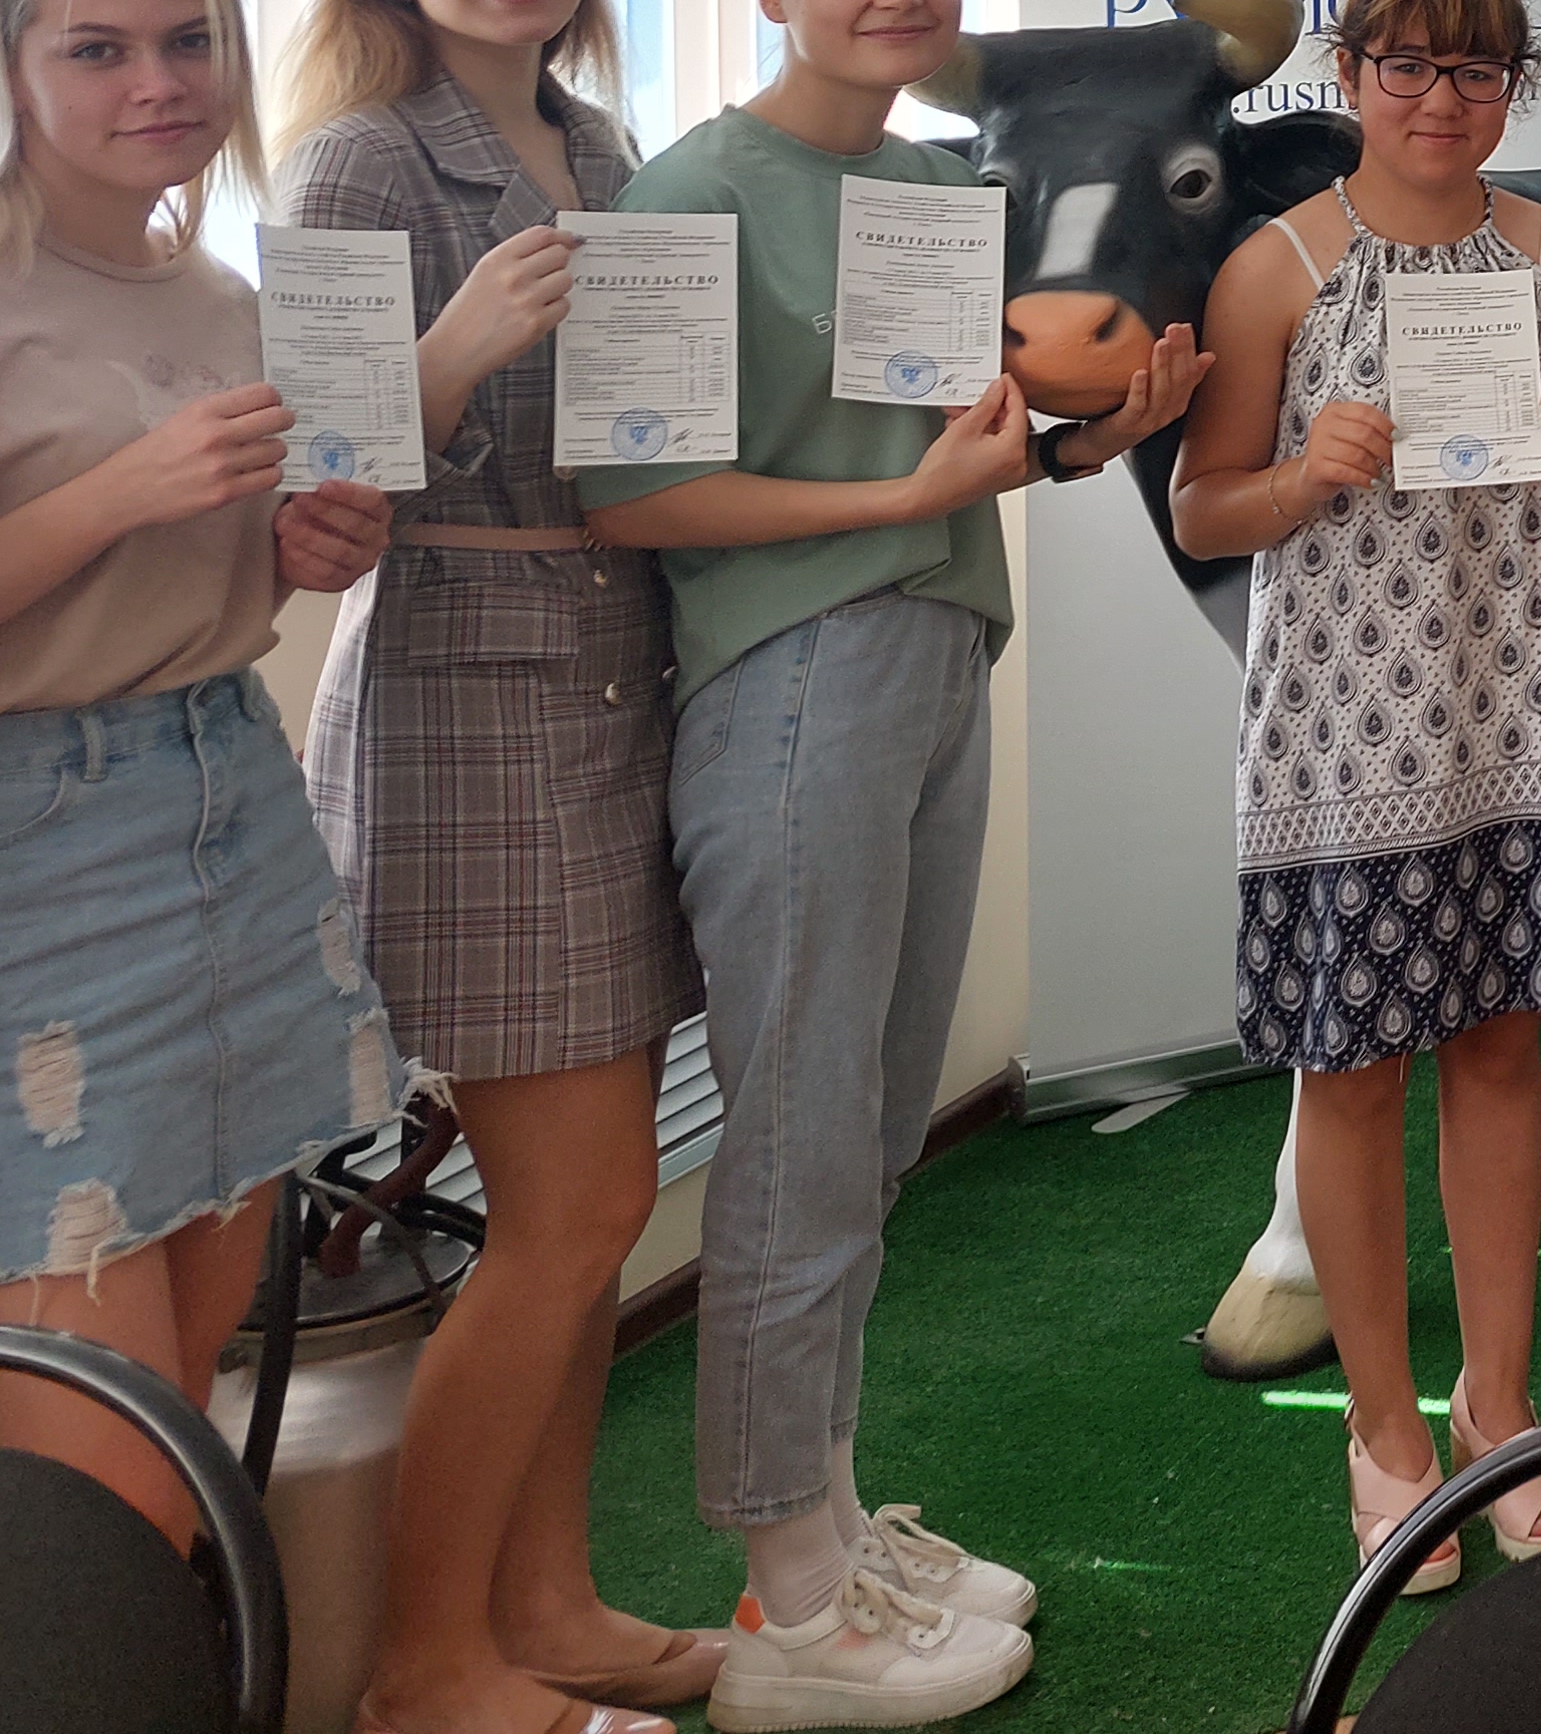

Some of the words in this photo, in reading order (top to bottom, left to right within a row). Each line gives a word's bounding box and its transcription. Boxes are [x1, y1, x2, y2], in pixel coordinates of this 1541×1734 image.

[855, 231, 989, 248] СВИДЕТЕЛЬСТВО
[575, 275, 720, 285] СВИДЕТЕЛЬСТВО
[1401, 322, 1523, 336] СВИДЕТЕЛЬСТВО
